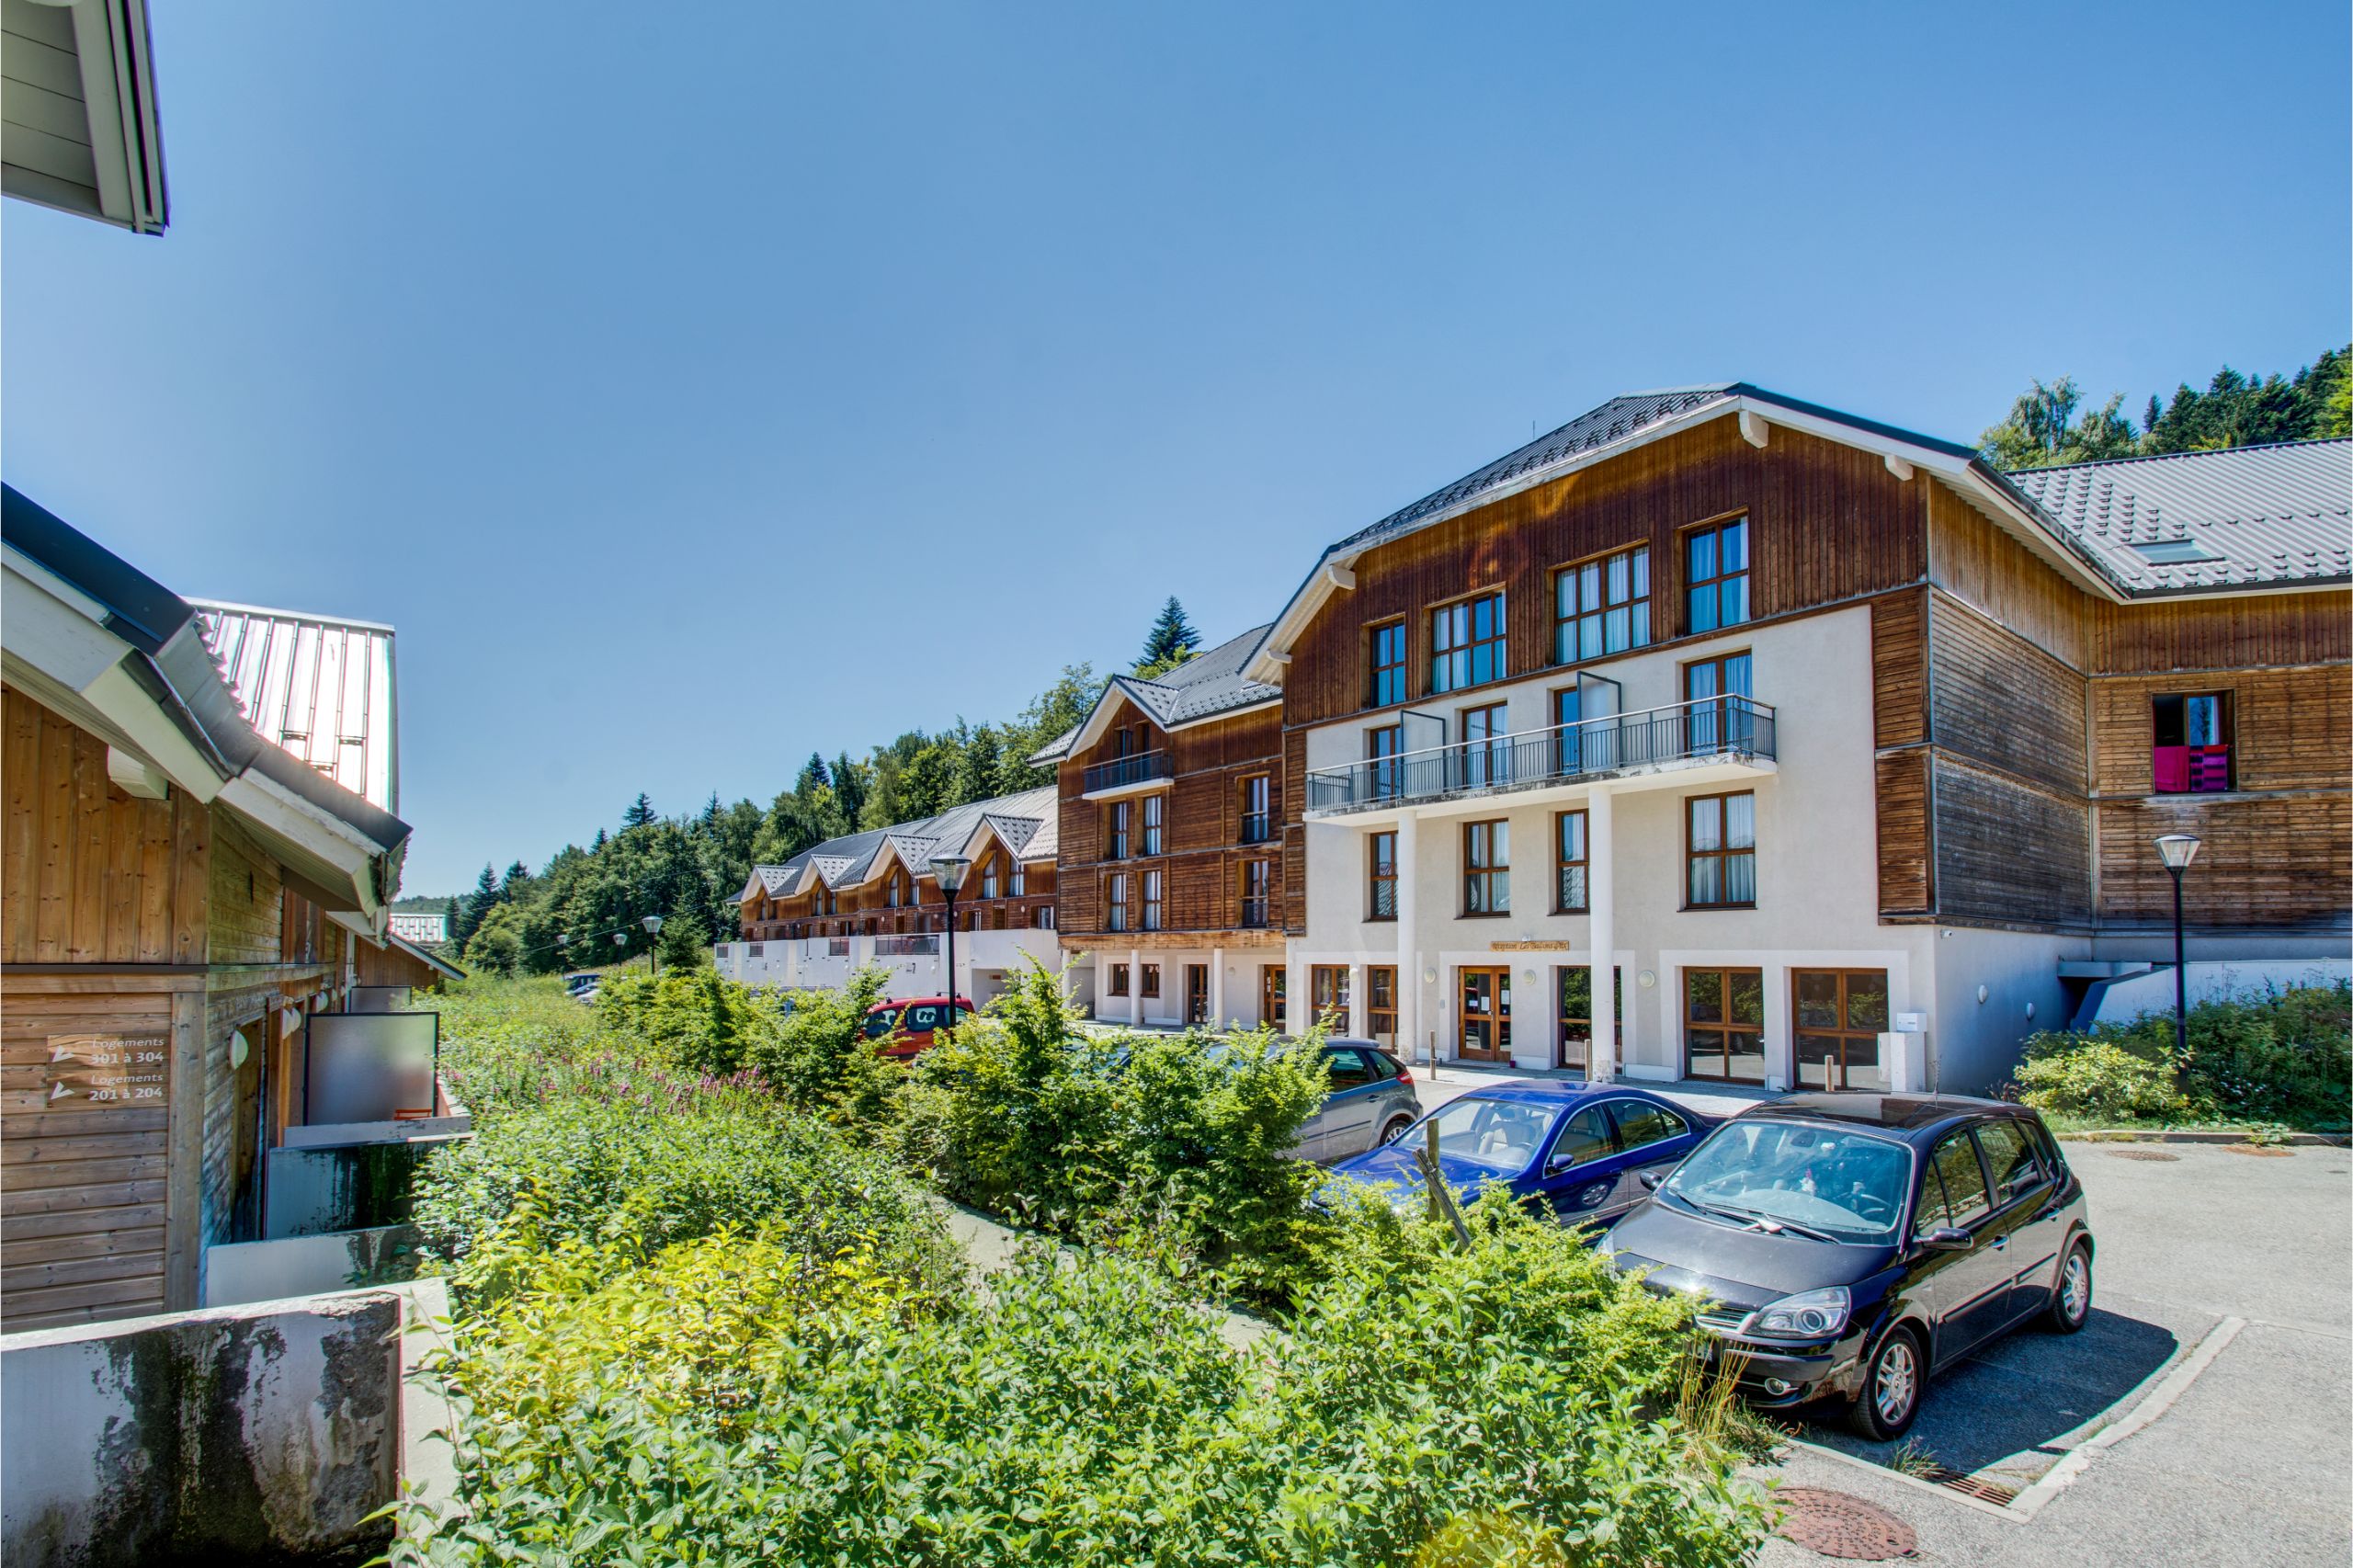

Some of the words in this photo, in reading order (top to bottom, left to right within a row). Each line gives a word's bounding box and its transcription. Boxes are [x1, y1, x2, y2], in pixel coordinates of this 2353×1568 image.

[92, 1039, 164, 1050] Logements
[91, 1053, 119, 1063] 301
[123, 1052, 132, 1063] à
[136, 1051, 164, 1062] 304
[91, 1074, 163, 1086] Logements
[89, 1089, 118, 1101] 201
[122, 1088, 131, 1099] à
[135, 1086, 163, 1098] 204
